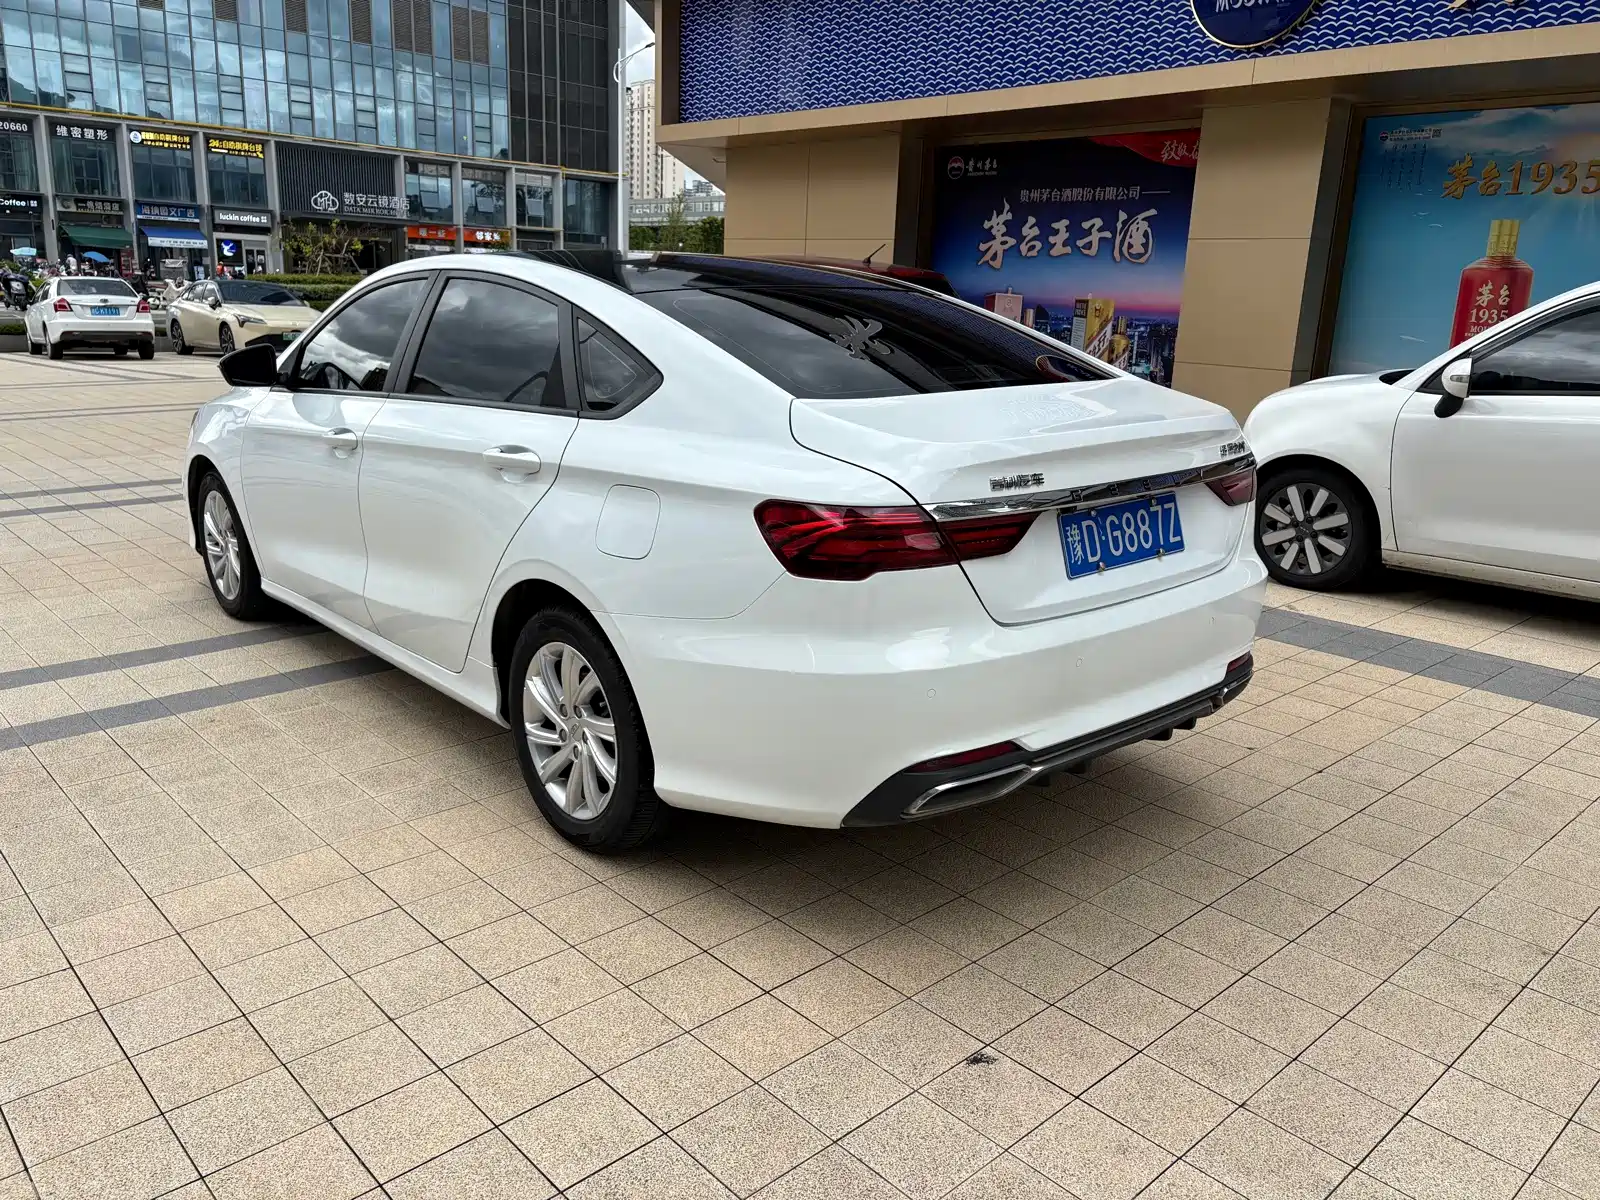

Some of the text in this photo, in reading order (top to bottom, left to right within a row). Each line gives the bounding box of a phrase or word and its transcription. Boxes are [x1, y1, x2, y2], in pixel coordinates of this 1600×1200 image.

[0, 121, 28, 132] 20660
[56, 125, 108, 140] 维密塑形
[343, 192, 410, 210] 数安云镜酒店
[1020, 186, 1140, 203] 贵州茅台酒股份有限公司
[0, 198, 26, 207] Coffee
[219, 213, 239, 221] luckin
[240, 215, 260, 223] coffee
[362, 207, 390, 215] MIRROR
[978, 198, 1157, 269] 茅台王子酒
[1474, 280, 1510, 307] 茅台
[1469, 309, 1509, 323] 1935
